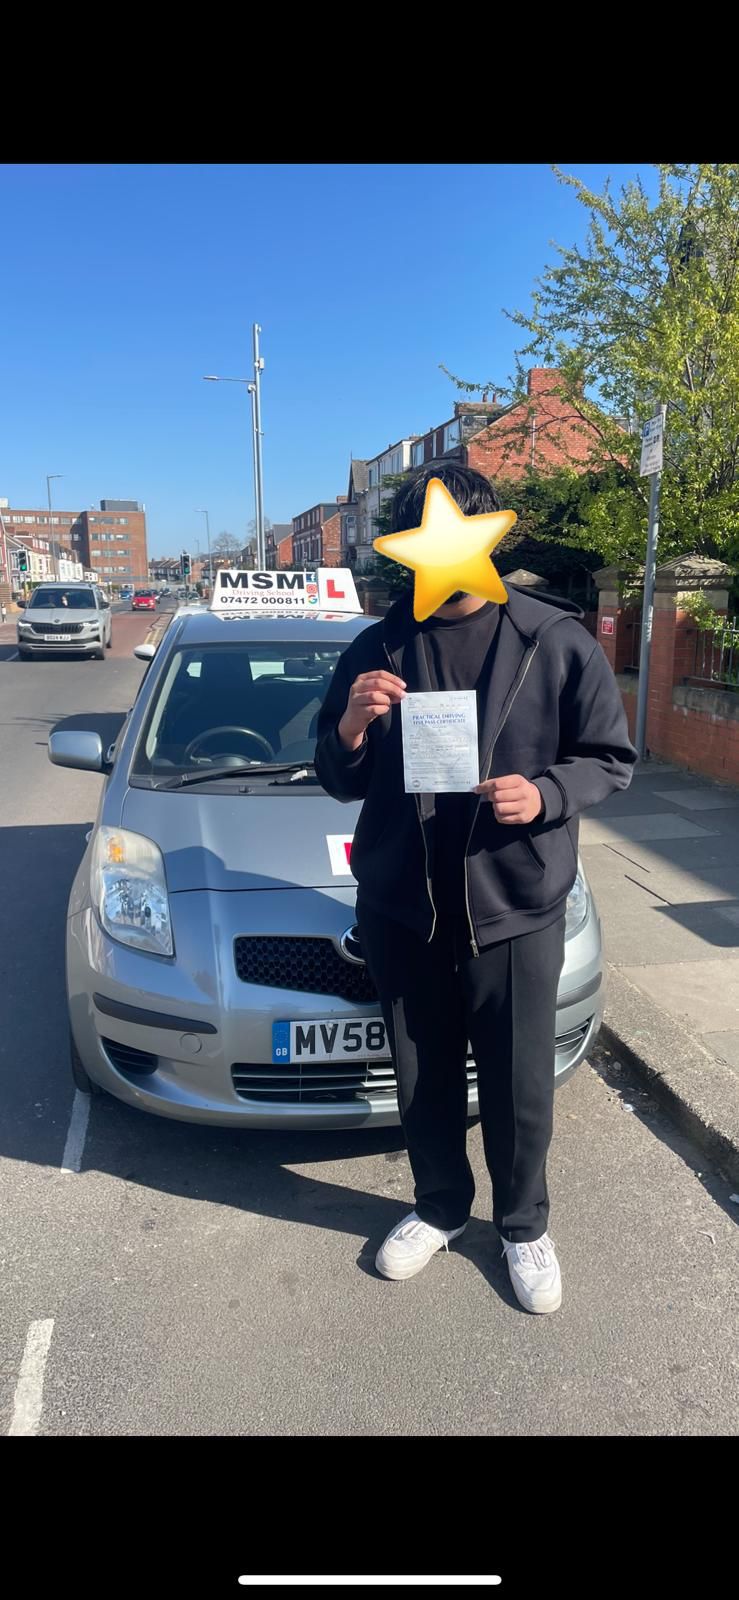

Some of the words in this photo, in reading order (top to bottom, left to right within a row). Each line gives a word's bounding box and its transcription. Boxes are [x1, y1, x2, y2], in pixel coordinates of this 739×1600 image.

[220, 572, 305, 589] MSM
[232, 589, 264, 597] Driving
[326, 579, 345, 598] L
[220, 596, 258, 604] 07472
[261, 596, 305, 605] 000811
[295, 1021, 385, 1056] MV58
[275, 1047, 288, 1057] GB
